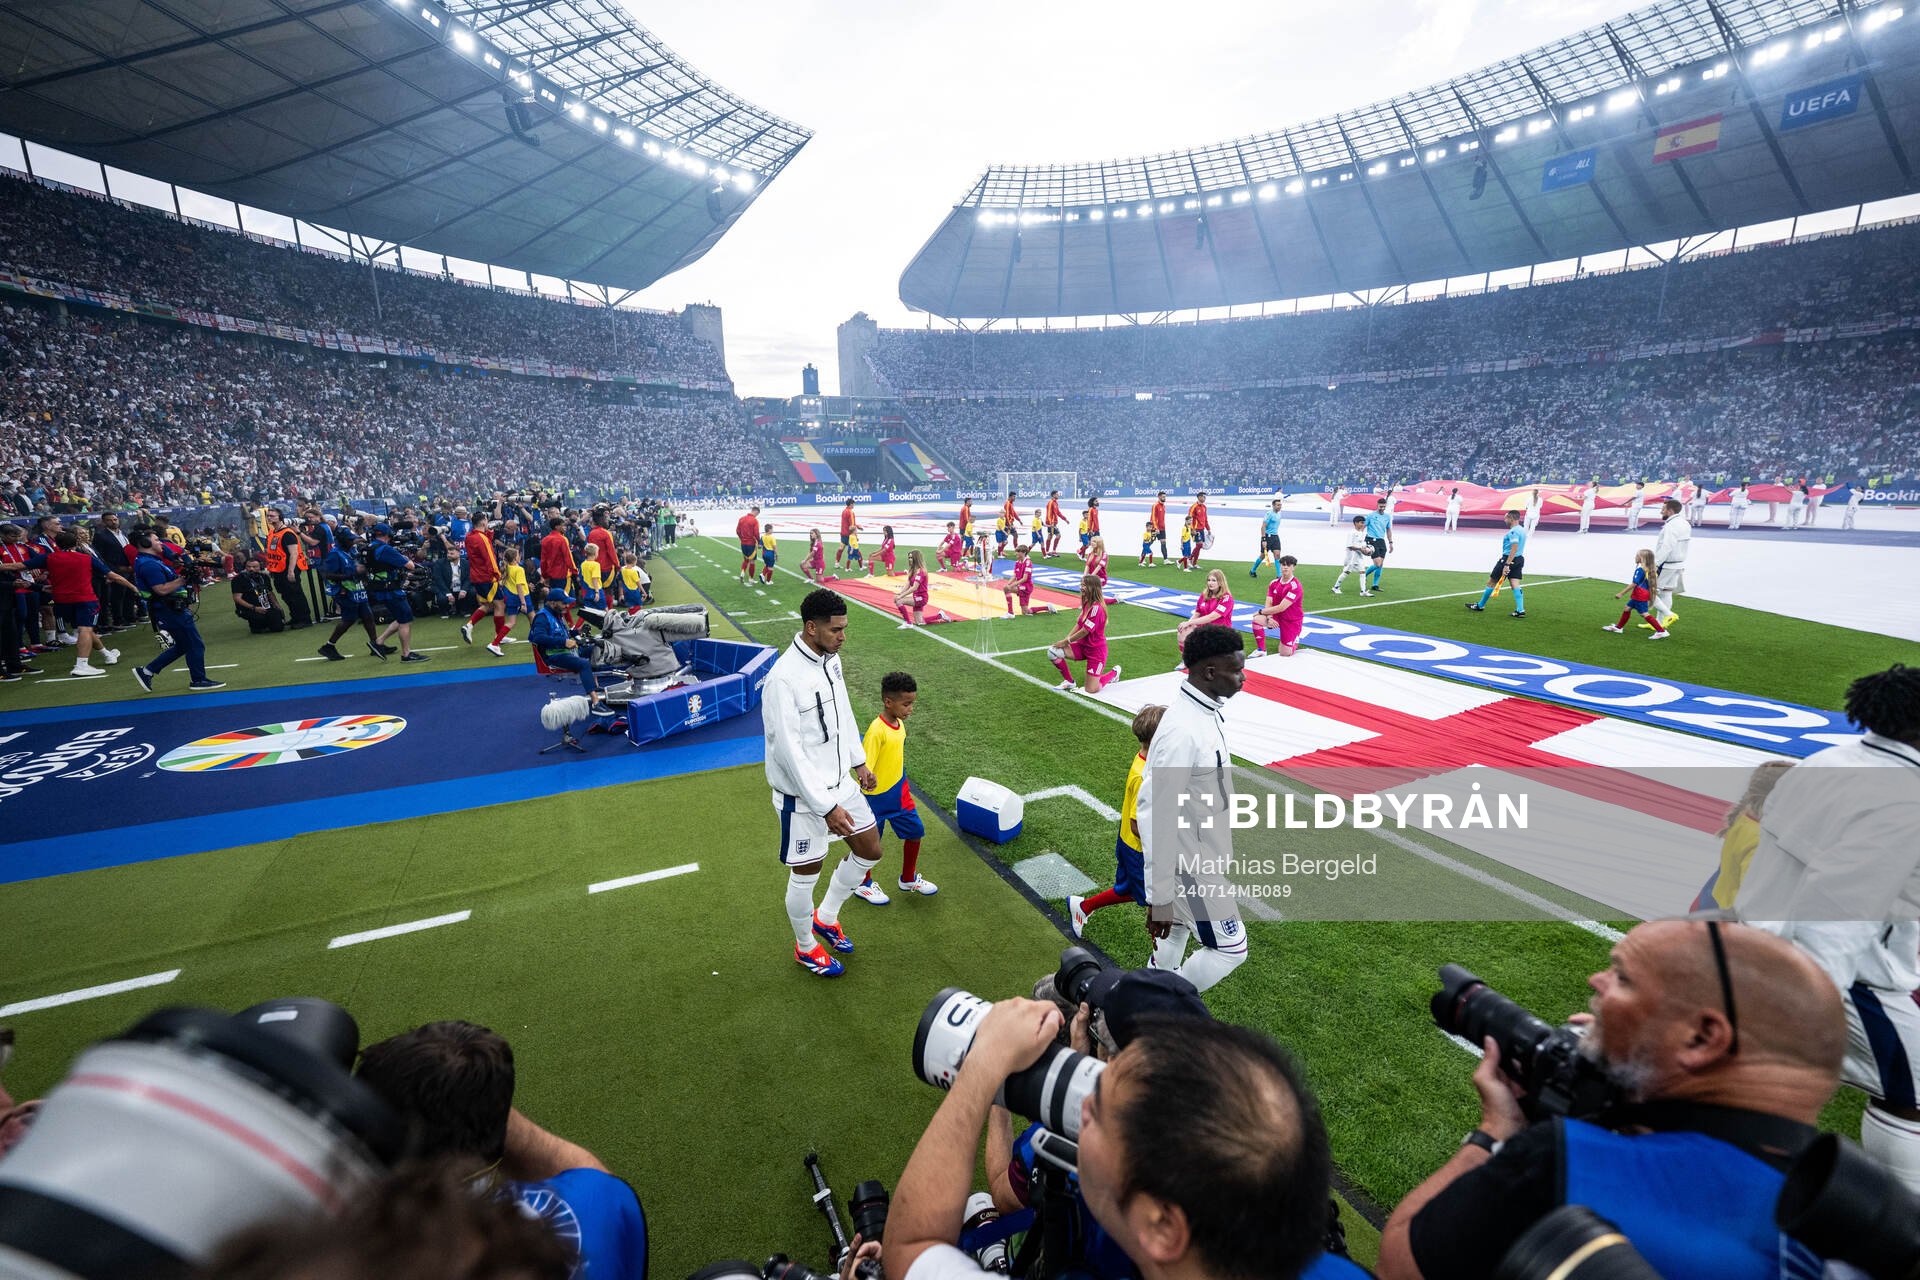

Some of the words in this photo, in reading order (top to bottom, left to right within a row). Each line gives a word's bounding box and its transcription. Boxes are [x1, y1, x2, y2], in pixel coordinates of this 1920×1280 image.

[1788, 89, 1850, 116] UEFA
[1239, 486, 1272, 494] Booking.com
[889, 491, 941, 502] Booking.com
